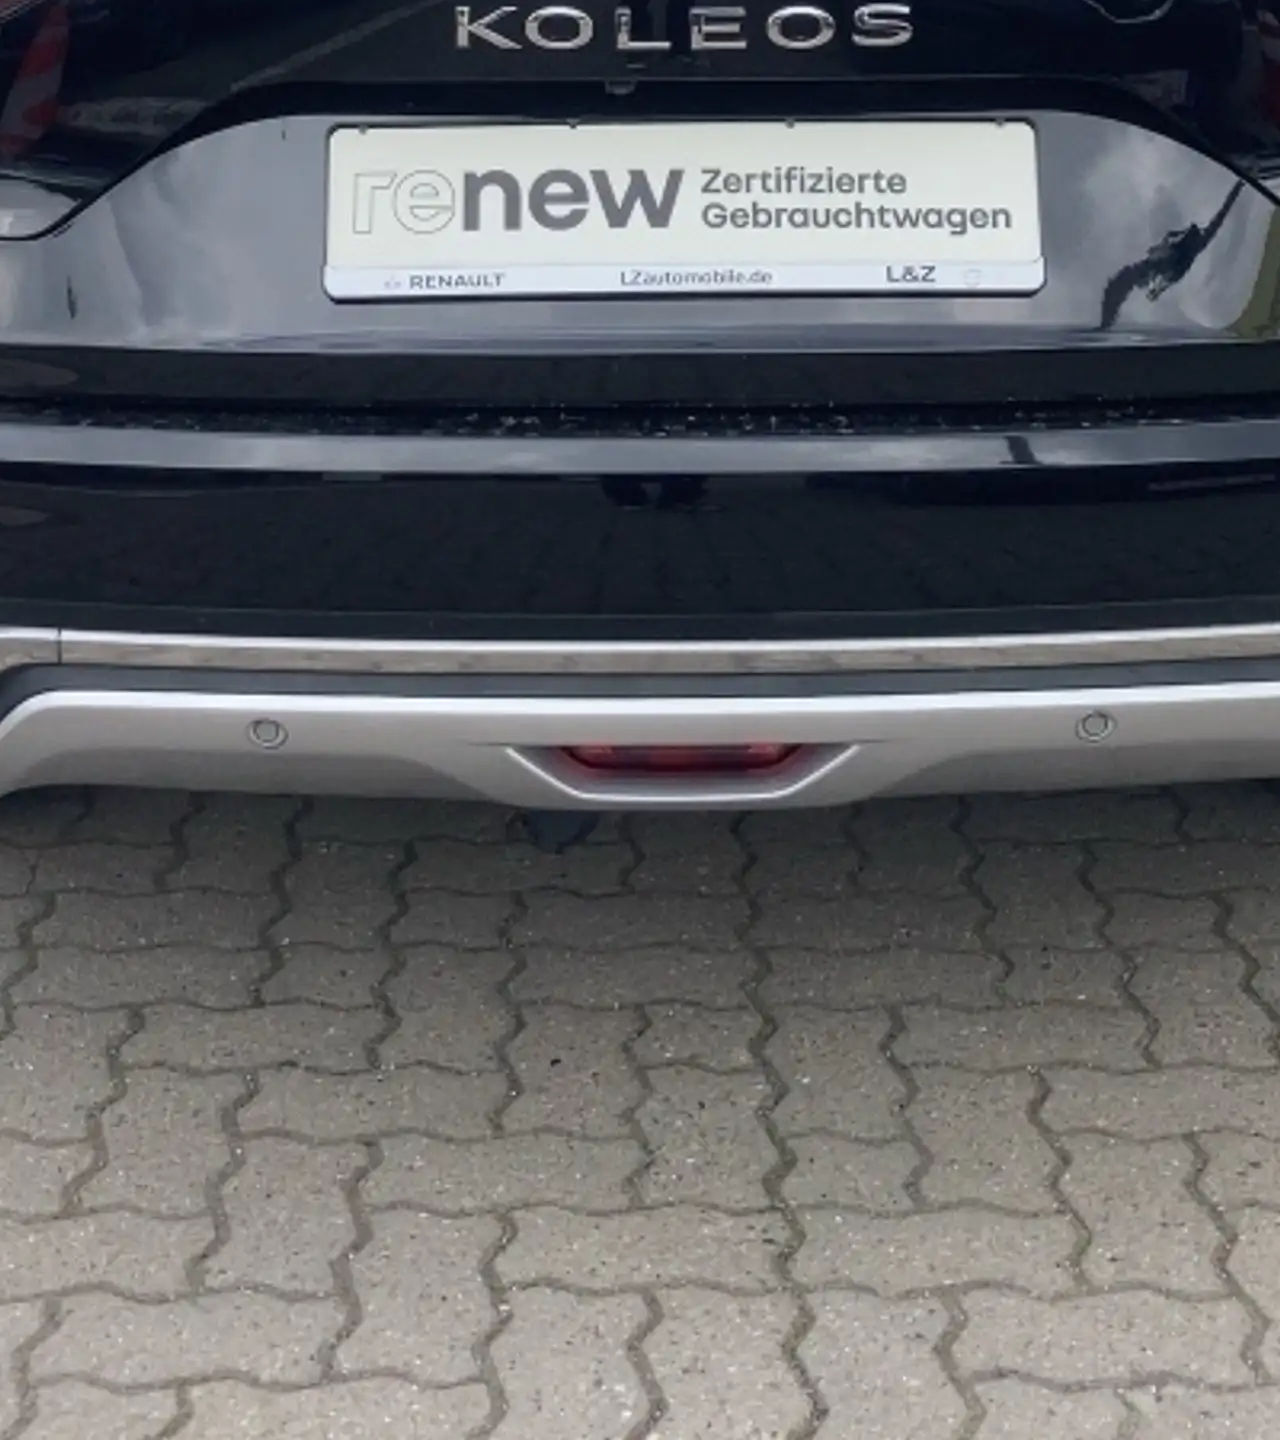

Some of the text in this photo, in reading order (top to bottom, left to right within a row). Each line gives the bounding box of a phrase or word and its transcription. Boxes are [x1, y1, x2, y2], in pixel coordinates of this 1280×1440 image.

[453, 3, 915, 50] KOLEOS
[700, 166, 908, 195] Zertifizierte
[352, 168, 686, 235] renew
[700, 201, 1013, 236] Gebrauchtwagen
[408, 265, 937, 290] RENAULT LZautomobile.de L&Z
